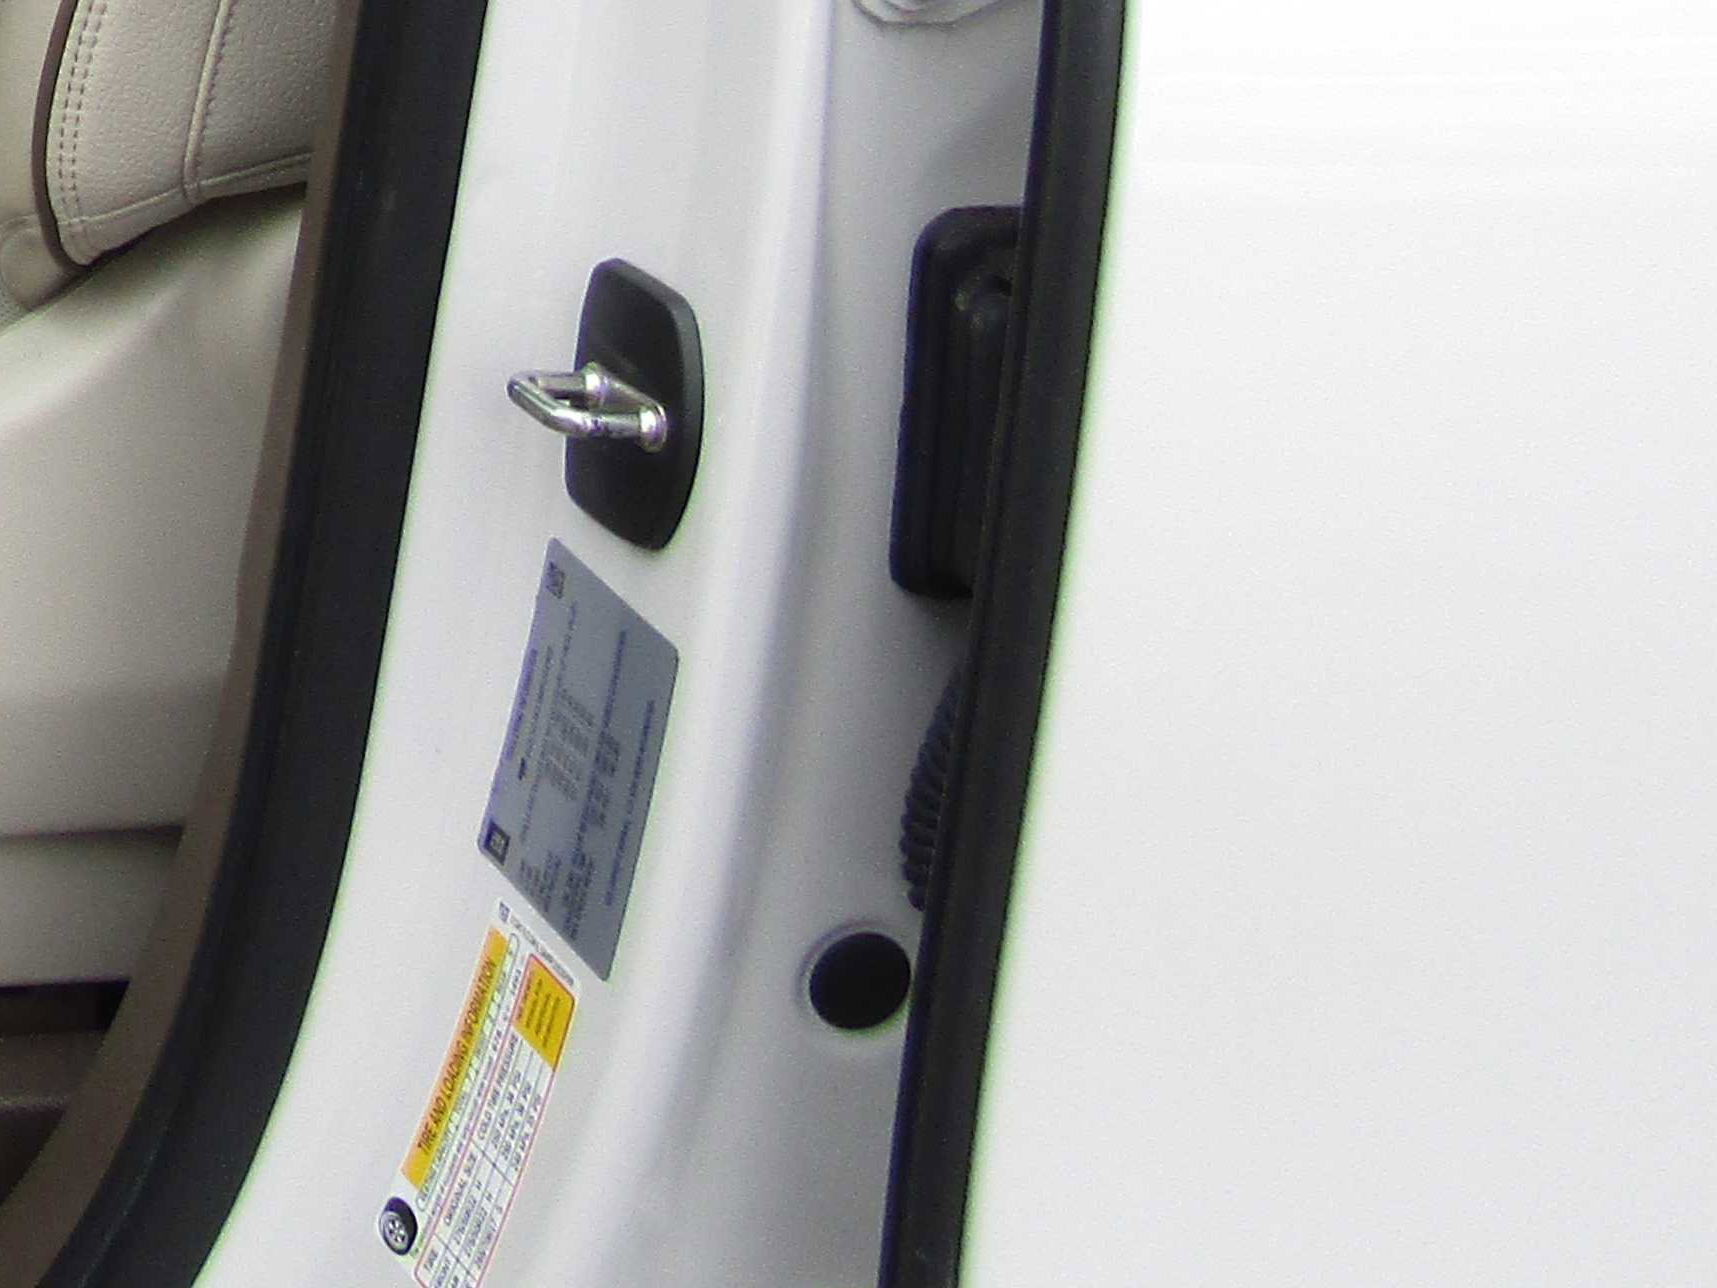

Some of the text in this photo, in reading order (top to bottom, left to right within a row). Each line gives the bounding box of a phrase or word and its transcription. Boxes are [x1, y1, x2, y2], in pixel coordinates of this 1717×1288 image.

[417, 1123, 436, 1156] TIRE
[428, 1094, 446, 1126] AND
[438, 1039, 467, 1101] LOADING
[459, 956, 497, 1043] INFORMATION
